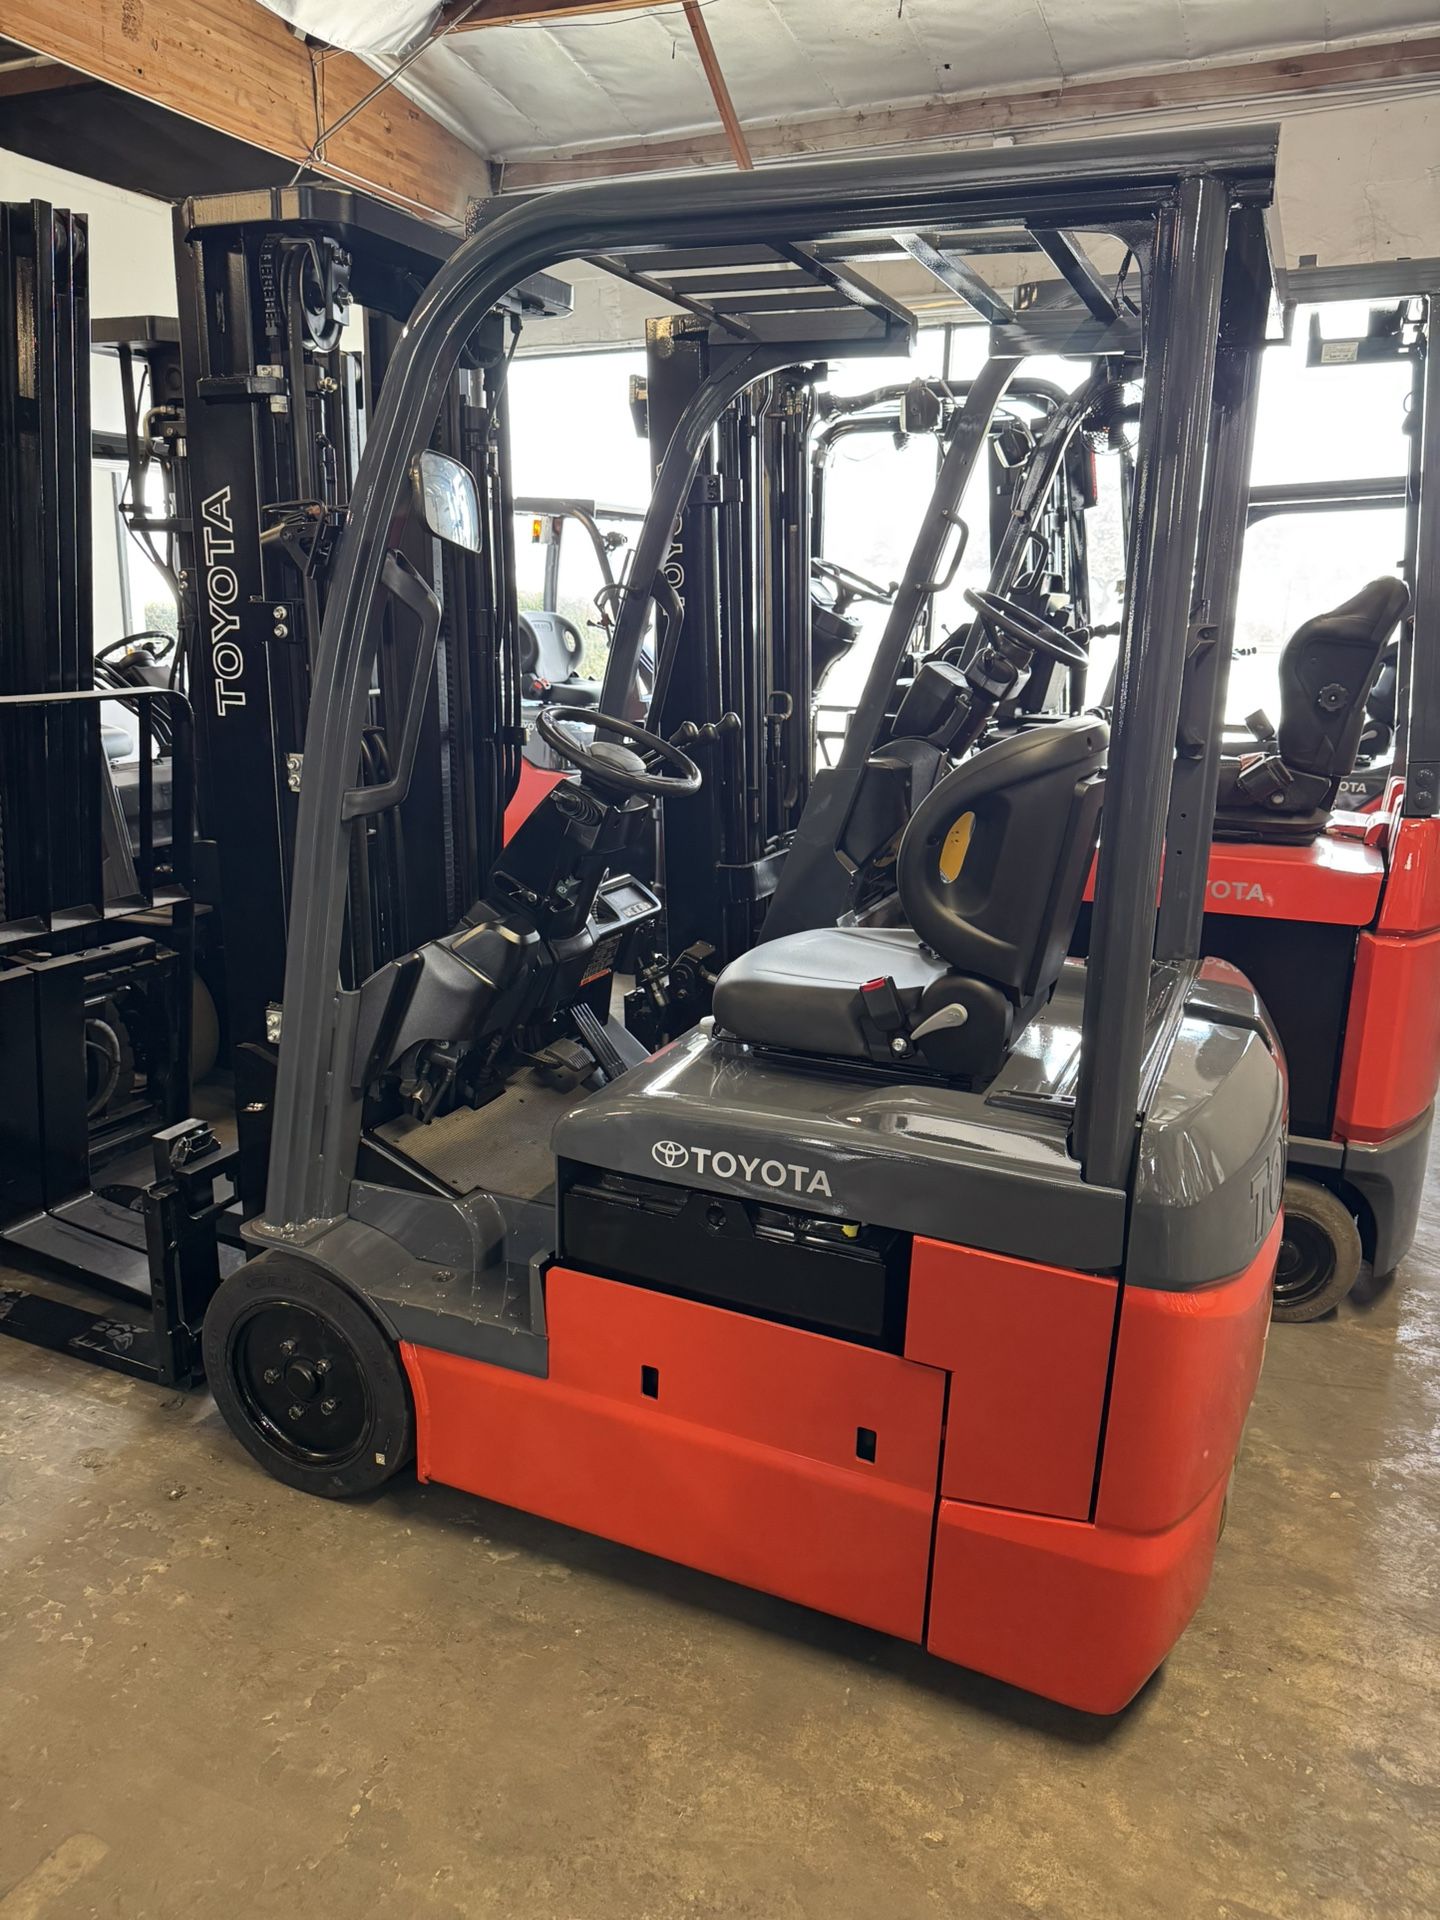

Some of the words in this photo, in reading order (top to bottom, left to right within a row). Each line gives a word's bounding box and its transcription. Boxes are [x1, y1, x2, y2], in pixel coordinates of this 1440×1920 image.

[202, 485, 246, 717] TOYOTA
[1206, 879, 1265, 902] OTA
[690, 1146, 833, 1198] TOYOTA
